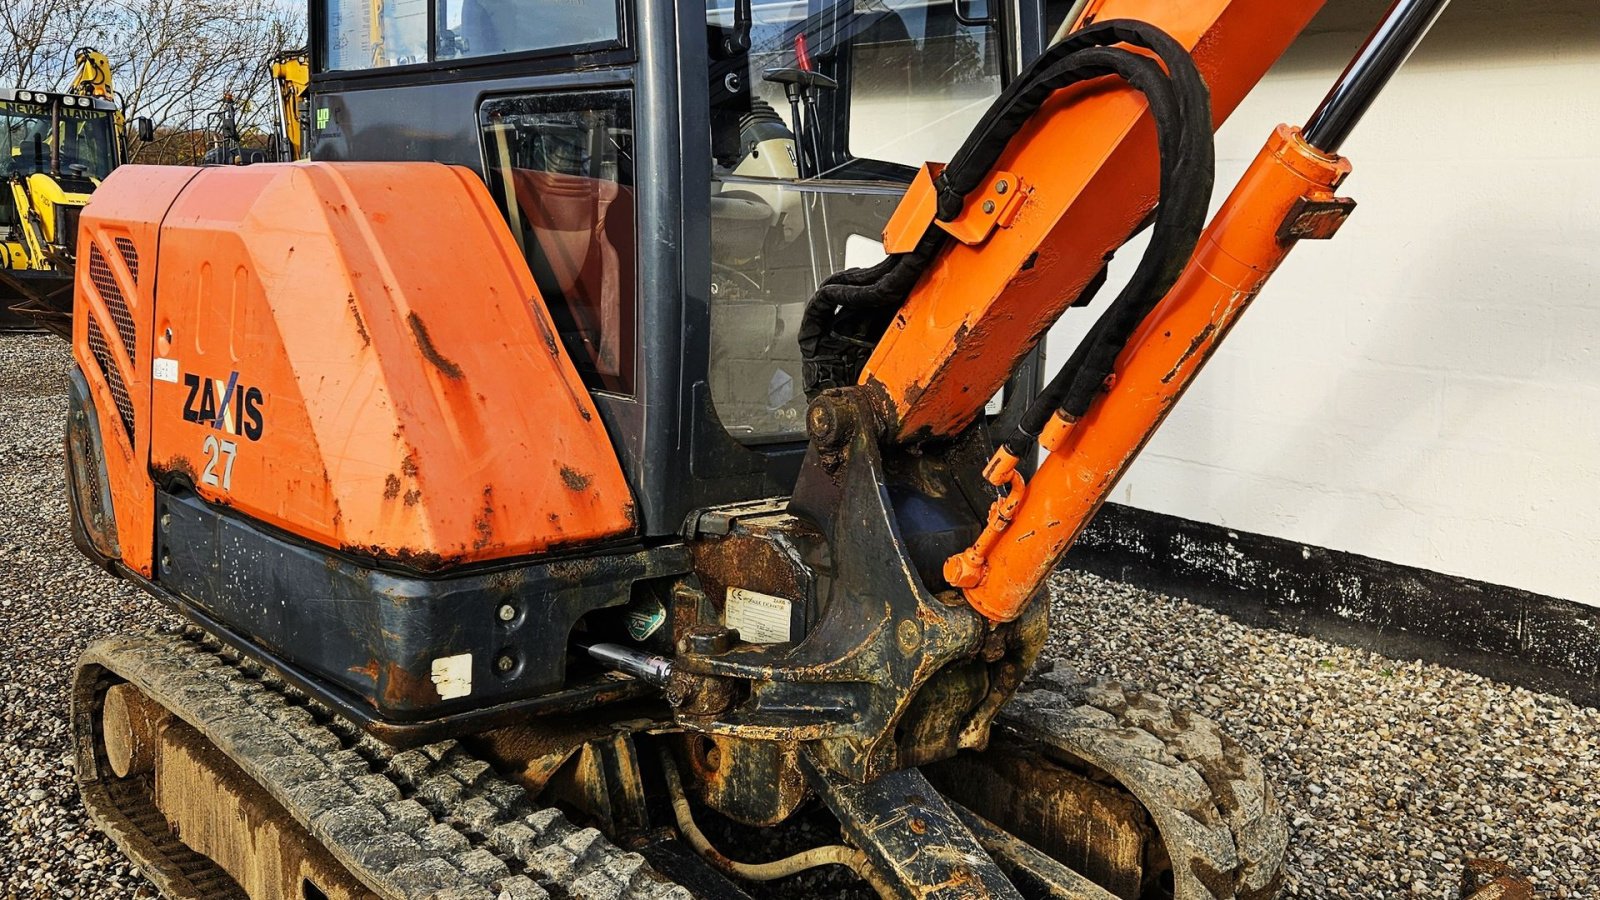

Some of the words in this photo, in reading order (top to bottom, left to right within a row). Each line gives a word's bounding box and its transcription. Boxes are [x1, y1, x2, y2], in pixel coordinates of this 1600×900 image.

[6, 103, 37, 115] NEW
[183, 372, 263, 441] ZAXIS
[202, 435, 237, 491] 27
